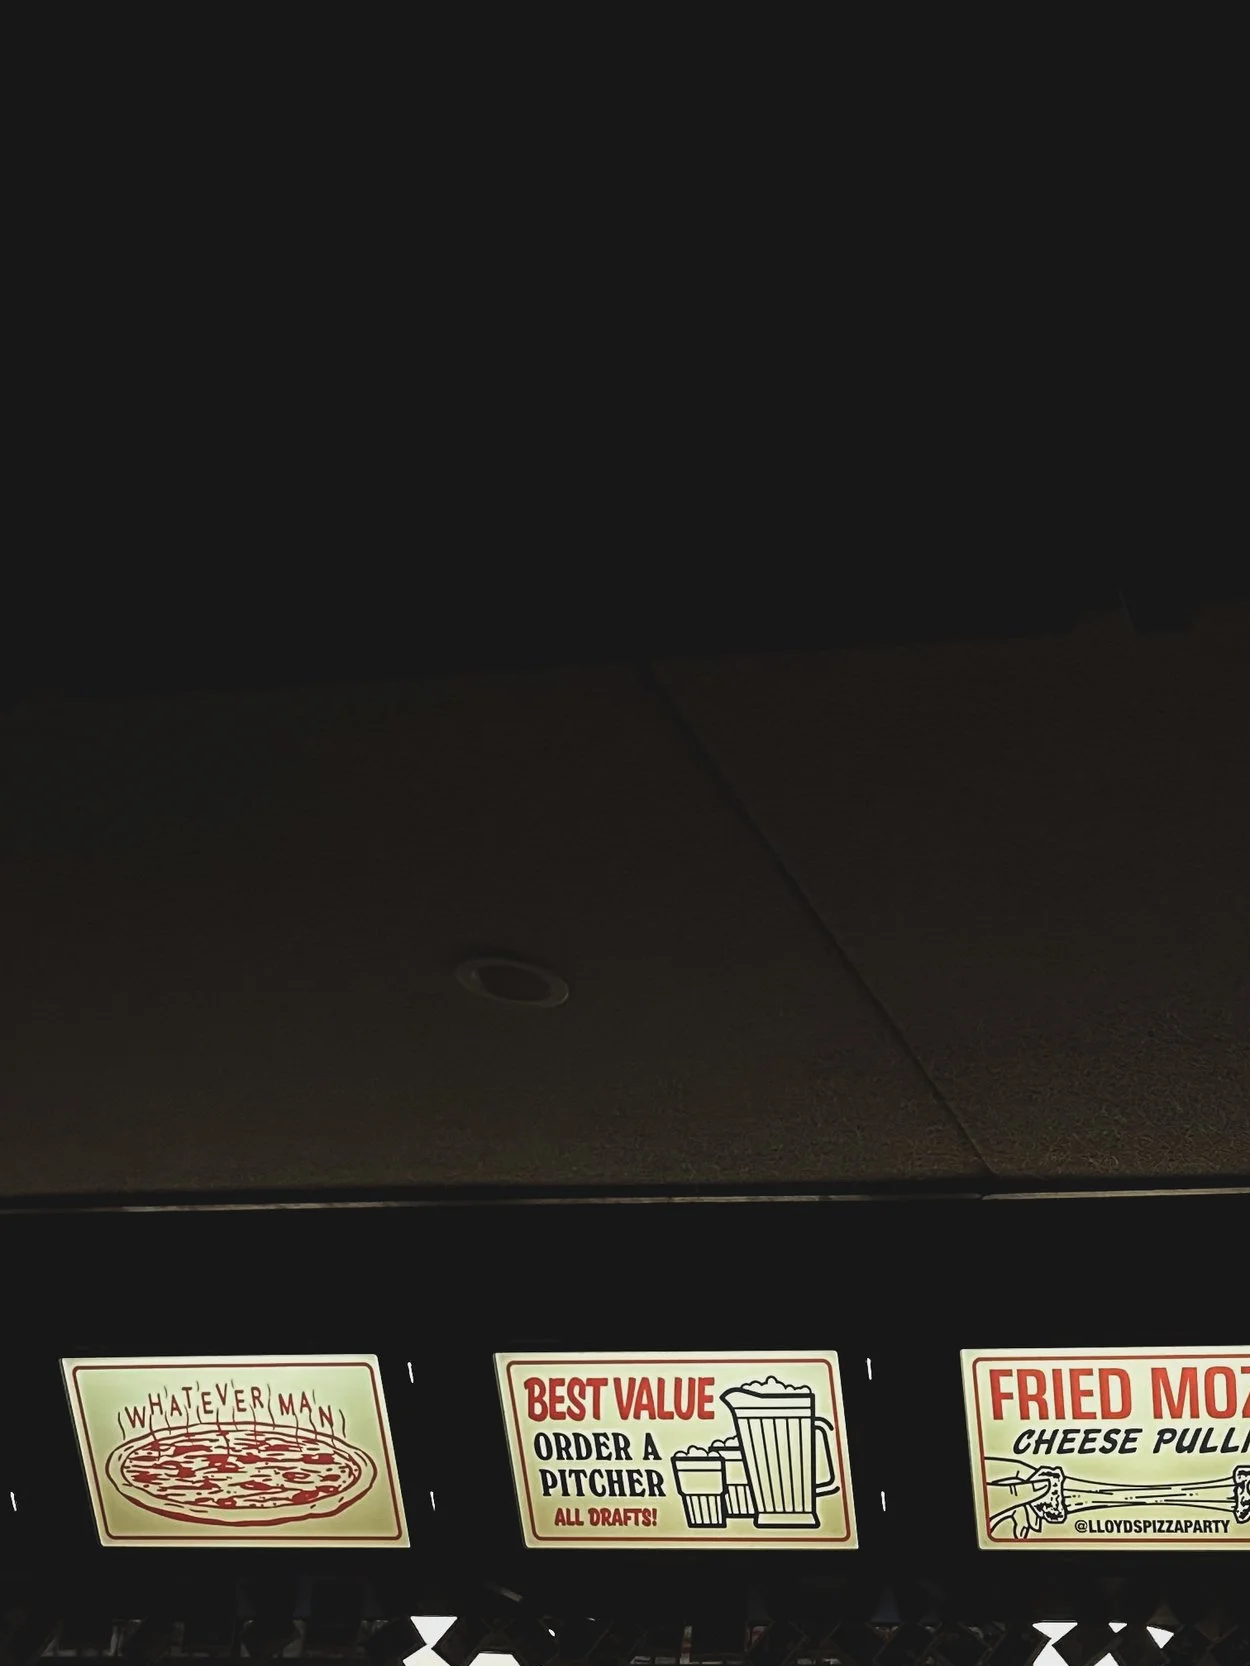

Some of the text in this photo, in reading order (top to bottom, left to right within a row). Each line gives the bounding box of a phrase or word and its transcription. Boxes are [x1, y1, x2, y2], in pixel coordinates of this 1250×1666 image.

[124, 1381, 336, 1429] WHATEVER MAN
[524, 1377, 714, 1422] BEST VALUE
[990, 1368, 1131, 1420] FRIED
[534, 1432, 662, 1461] ORDER A
[1013, 1429, 1142, 1454] CHEESE
[539, 1469, 665, 1497] PITCHER
[554, 1508, 657, 1527] ALL DRAFTS!
[1075, 1520, 1230, 1533] @LLOYDSPIZZAPARTY
